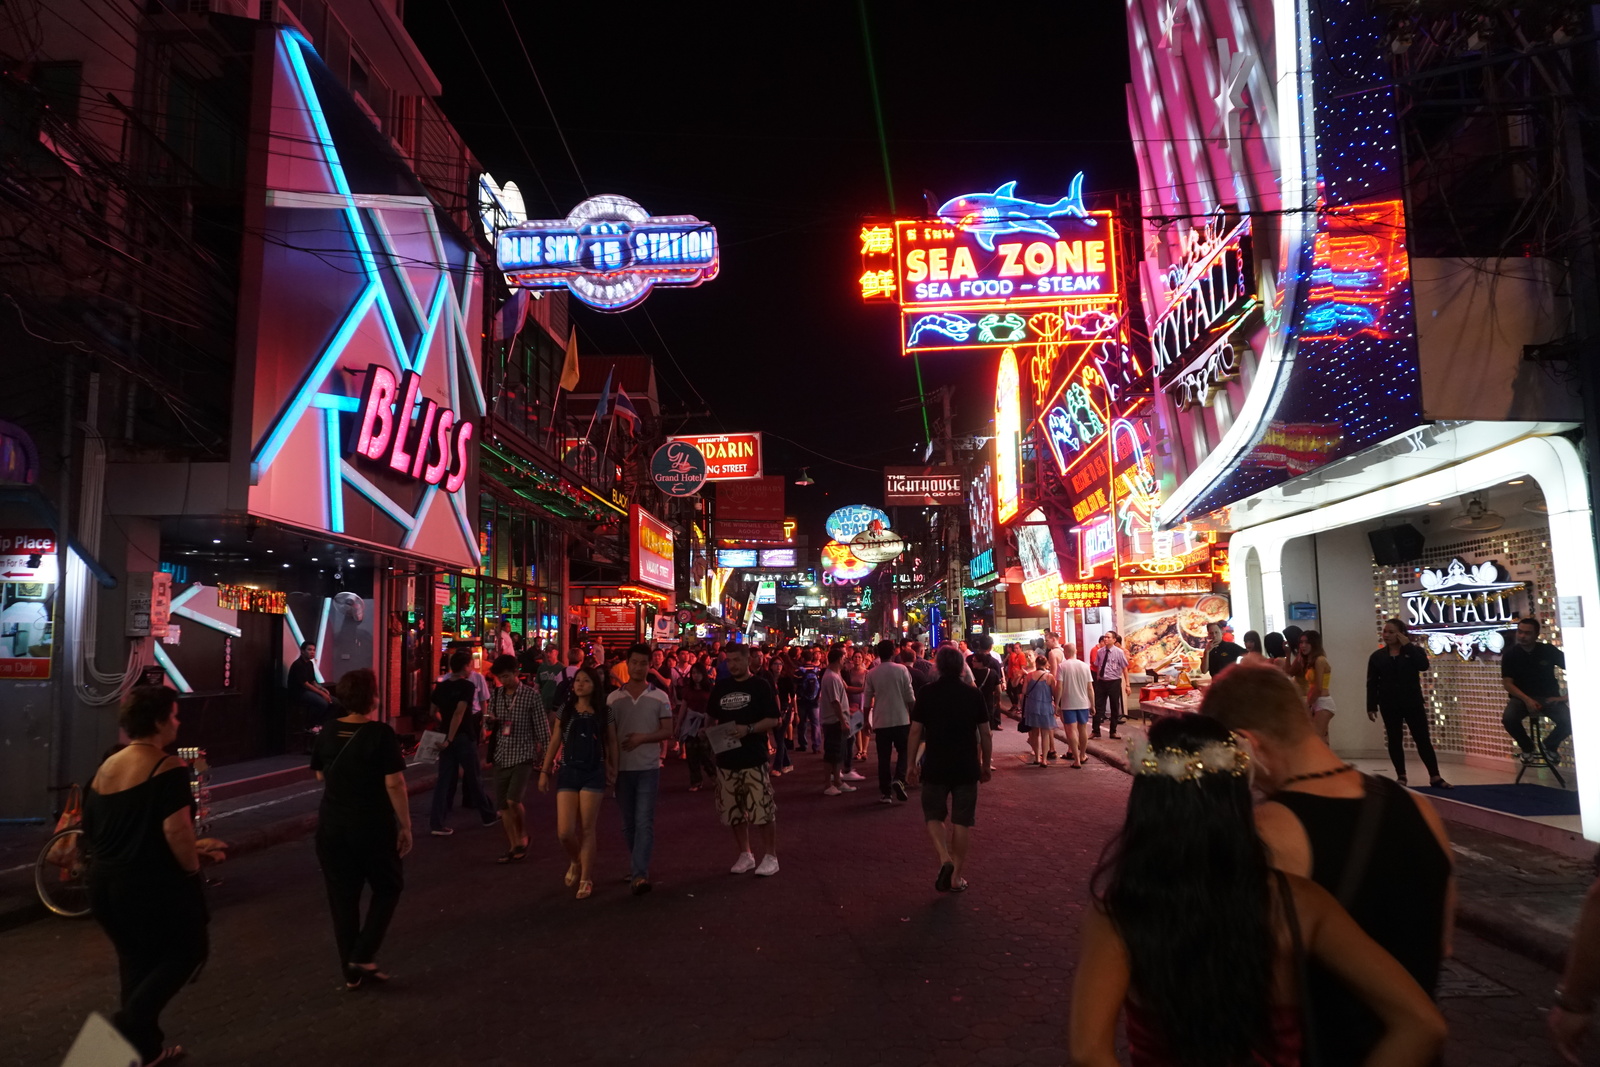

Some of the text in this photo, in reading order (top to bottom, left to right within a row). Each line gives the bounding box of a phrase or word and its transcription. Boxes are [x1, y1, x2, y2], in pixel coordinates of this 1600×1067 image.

[501, 235, 578, 264] BLUE SKY
[589, 241, 621, 267] 15
[635, 231, 712, 260] STATION
[906, 240, 1106, 282] SEA ZONE
[915, 281, 953, 299] SEA
[960, 280, 1014, 297] FOOD
[1037, 275, 1101, 293] STEAK
[1152, 249, 1238, 378] SKYFALL
[356, 364, 473, 493] BLISS
[655, 473, 702, 482] Grand Hotel
[722, 464, 748, 473] STREET
[888, 480, 961, 492] LIGHTHOUSE
[15, 534, 52, 549] Place
[1406, 590, 1513, 626] SKYFALL
